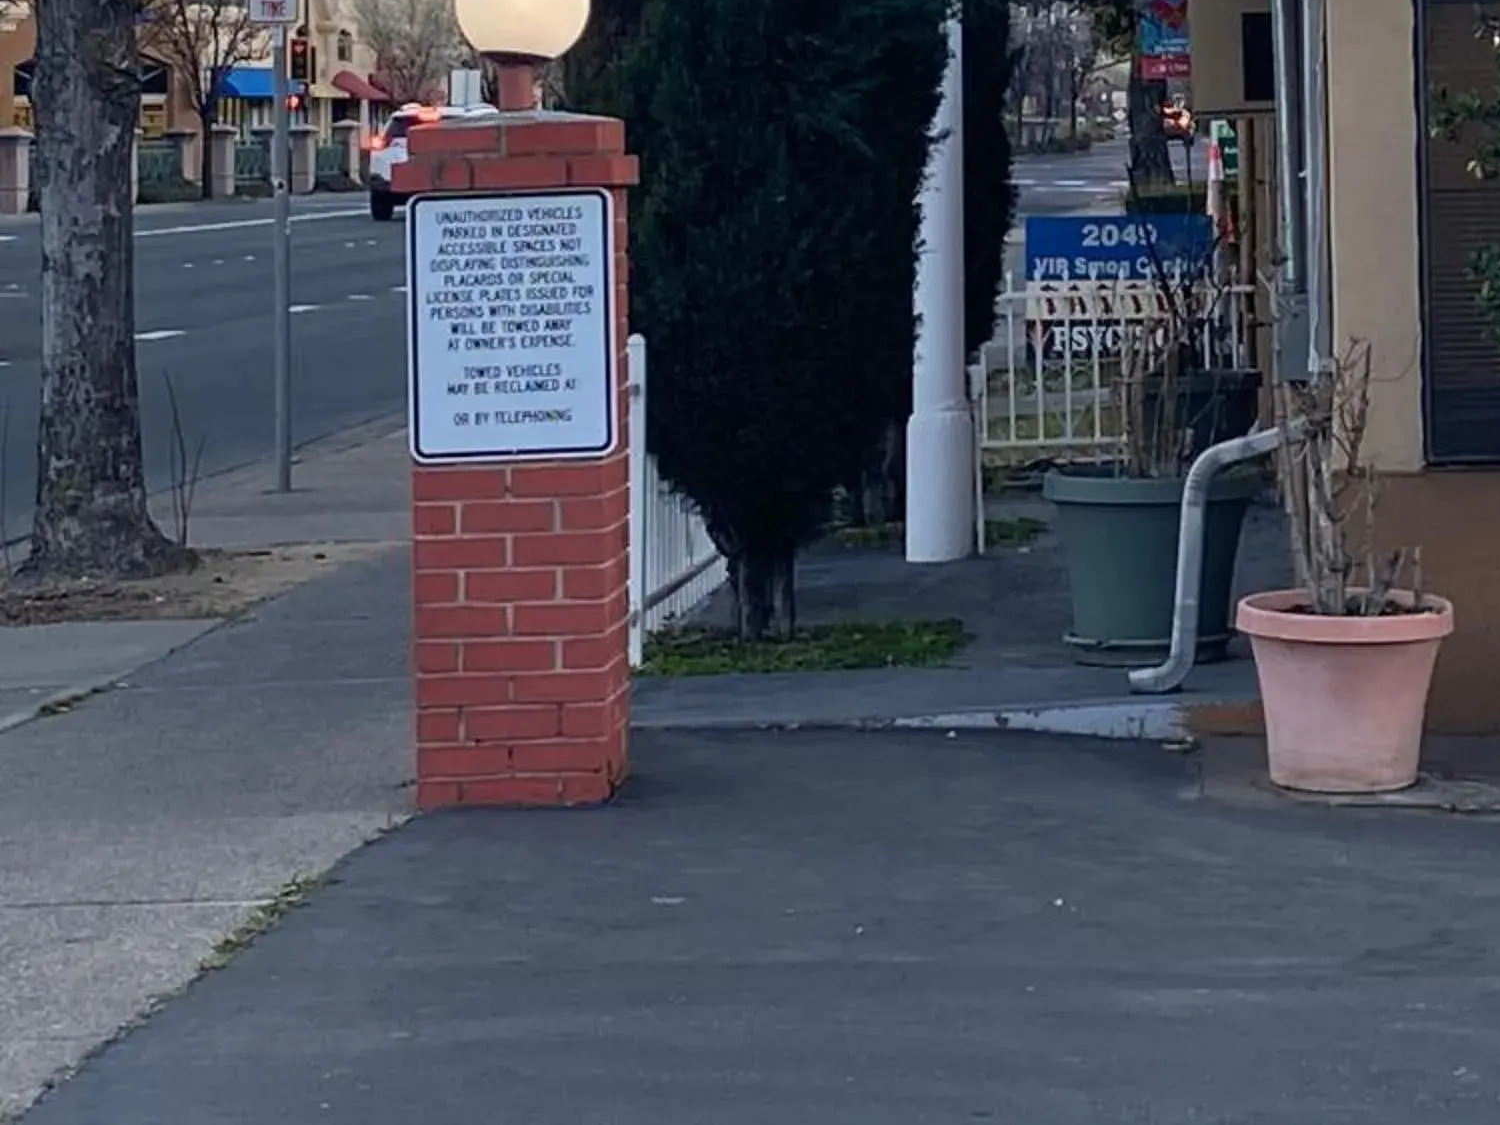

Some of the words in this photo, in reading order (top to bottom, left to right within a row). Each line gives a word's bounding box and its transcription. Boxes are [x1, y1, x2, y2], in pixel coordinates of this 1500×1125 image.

[260, 0, 287, 16] TIME
[436, 209, 522, 225] UNAUTHORIZED
[528, 206, 582, 220] VEHICLES
[442, 226, 486, 239] PARKED
[491, 225, 502, 236] IN
[508, 223, 576, 236] DESIGNATED
[437, 242, 507, 255] ACCESSIBLE
[514, 240, 555, 252] SPACES
[560, 239, 581, 251] NOT
[430, 258, 496, 272] DISPLAYING
[502, 255, 589, 269] DISTINGUISHING
[1075, 257, 1132, 276] Smog
[444, 274, 503, 286] PLACARDS
[508, 273, 523, 285] OR
[529, 271, 576, 283] SPECIAL
[426, 291, 473, 304] LICENSE
[479, 290, 520, 301] PLATES
[526, 287, 567, 300] ISSUED
[572, 285, 594, 298] FOR
[431, 306, 484, 320] PERSONS
[489, 305, 515, 317] WITH
[520, 302, 591, 316] DISABILITIES
[451, 323, 475, 334] WILL
[482, 322, 495, 333] BE
[502, 320, 539, 332] TOWED
[544, 318, 572, 330] AWAY
[448, 339, 460, 351] AT
[466, 336, 516, 350] OWNER'S
[464, 366, 500, 379] TOWED
[507, 363, 562, 376] VEHICLES
[448, 383, 469, 395] MAY
[475, 381, 489, 393] BE
[495, 379, 559, 392] RECLAIMED
[564, 378, 576, 390] AT
[454, 413, 469, 425] OR
[475, 411, 489, 424] BY
[496, 408, 572, 423] TELEPHONING
